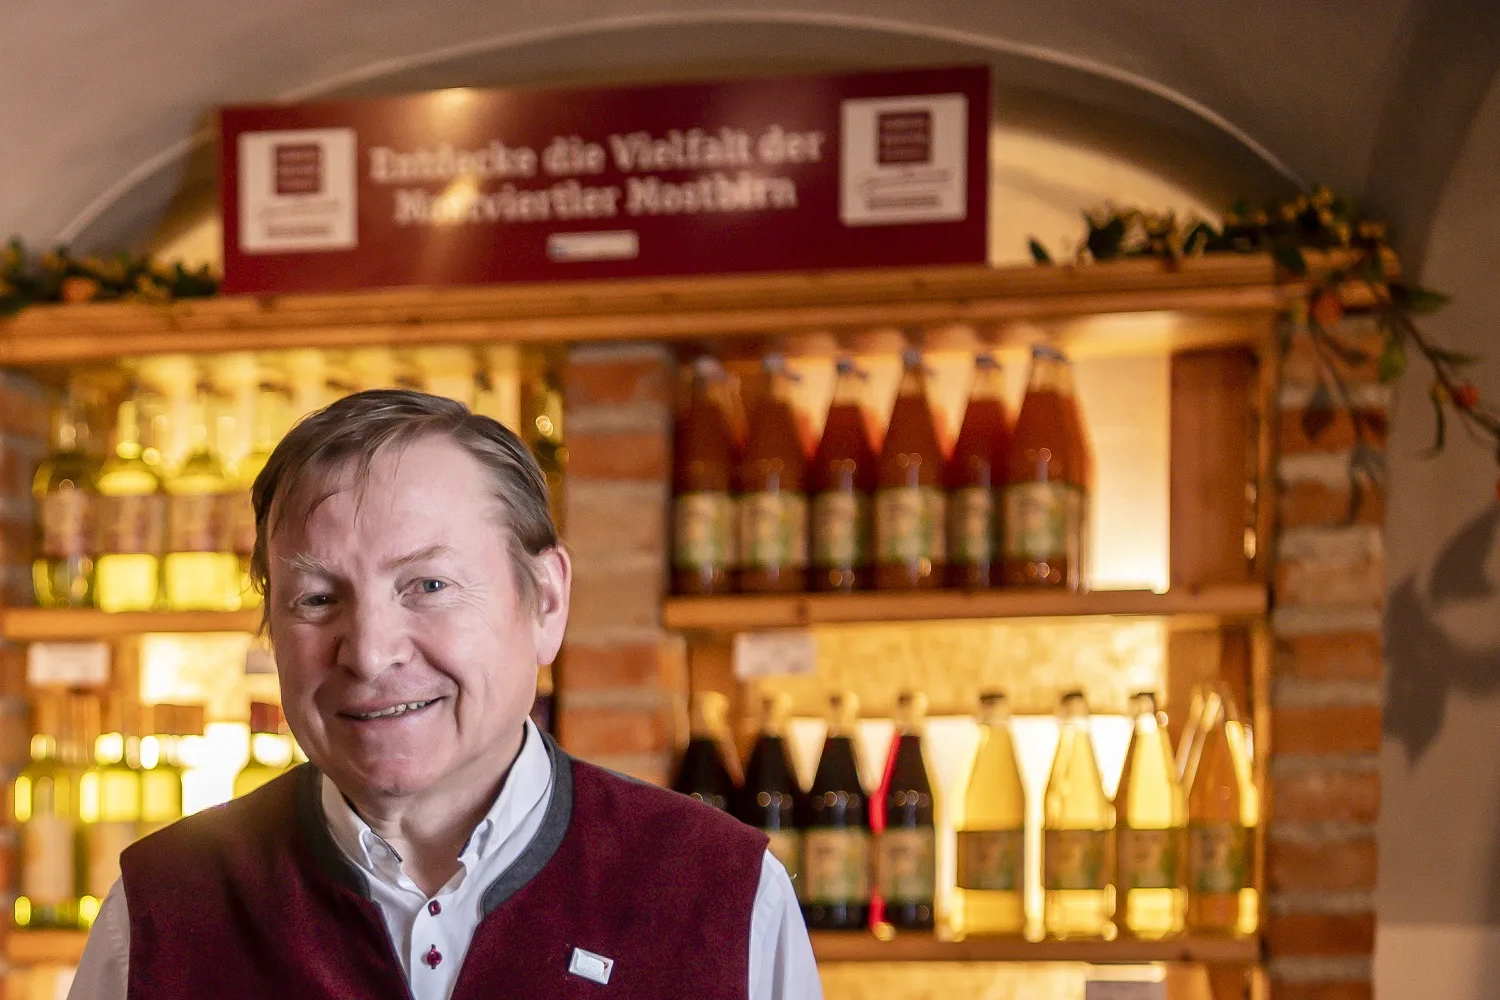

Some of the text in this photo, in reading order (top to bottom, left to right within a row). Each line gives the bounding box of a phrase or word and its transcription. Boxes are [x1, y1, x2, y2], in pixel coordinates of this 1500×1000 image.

[542, 135, 606, 175] die
[608, 127, 752, 173] Vielfalt
[757, 123, 827, 166] der
[395, 179, 622, 227] Mviertler
